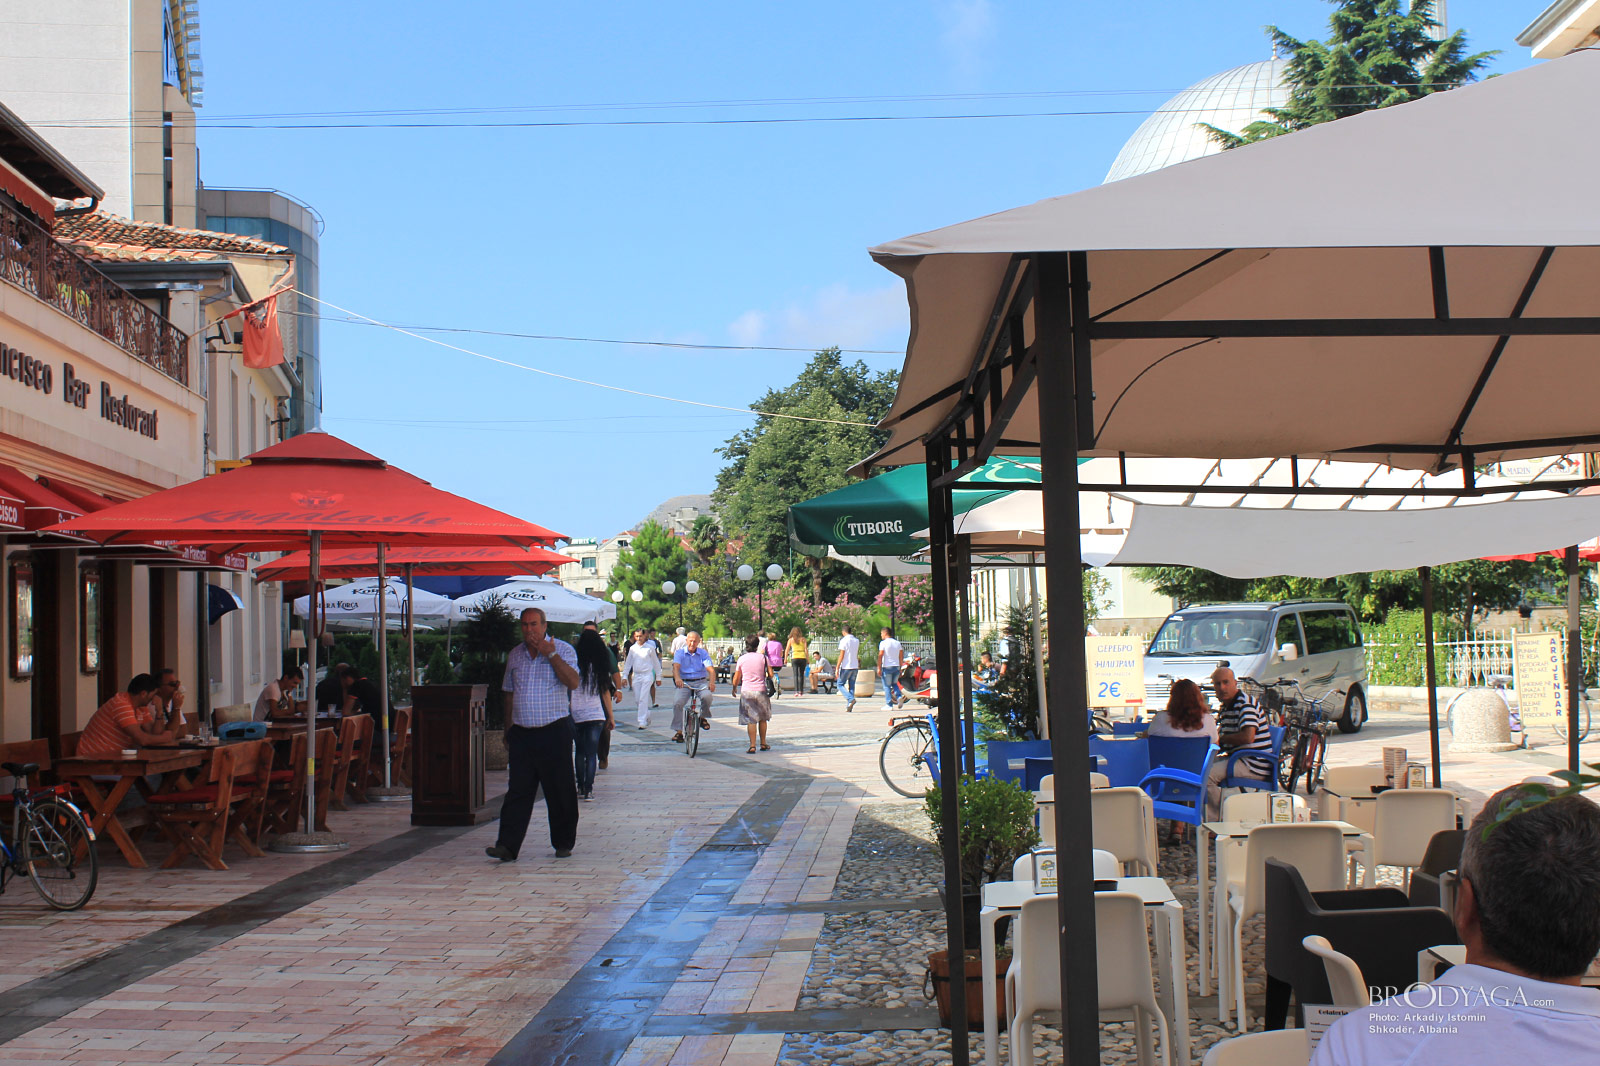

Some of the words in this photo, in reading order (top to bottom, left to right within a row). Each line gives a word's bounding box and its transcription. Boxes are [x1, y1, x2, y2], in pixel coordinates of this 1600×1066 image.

[63, 362, 91, 410] Bar
[101, 380, 158, 441] Restorant
[847, 519, 903, 537] TUBORG
[1097, 644, 1133, 653] СЕРЕБРО
[1550, 638, 1562, 717] ARGJENDAR
[1097, 681, 1121, 698] 2€
